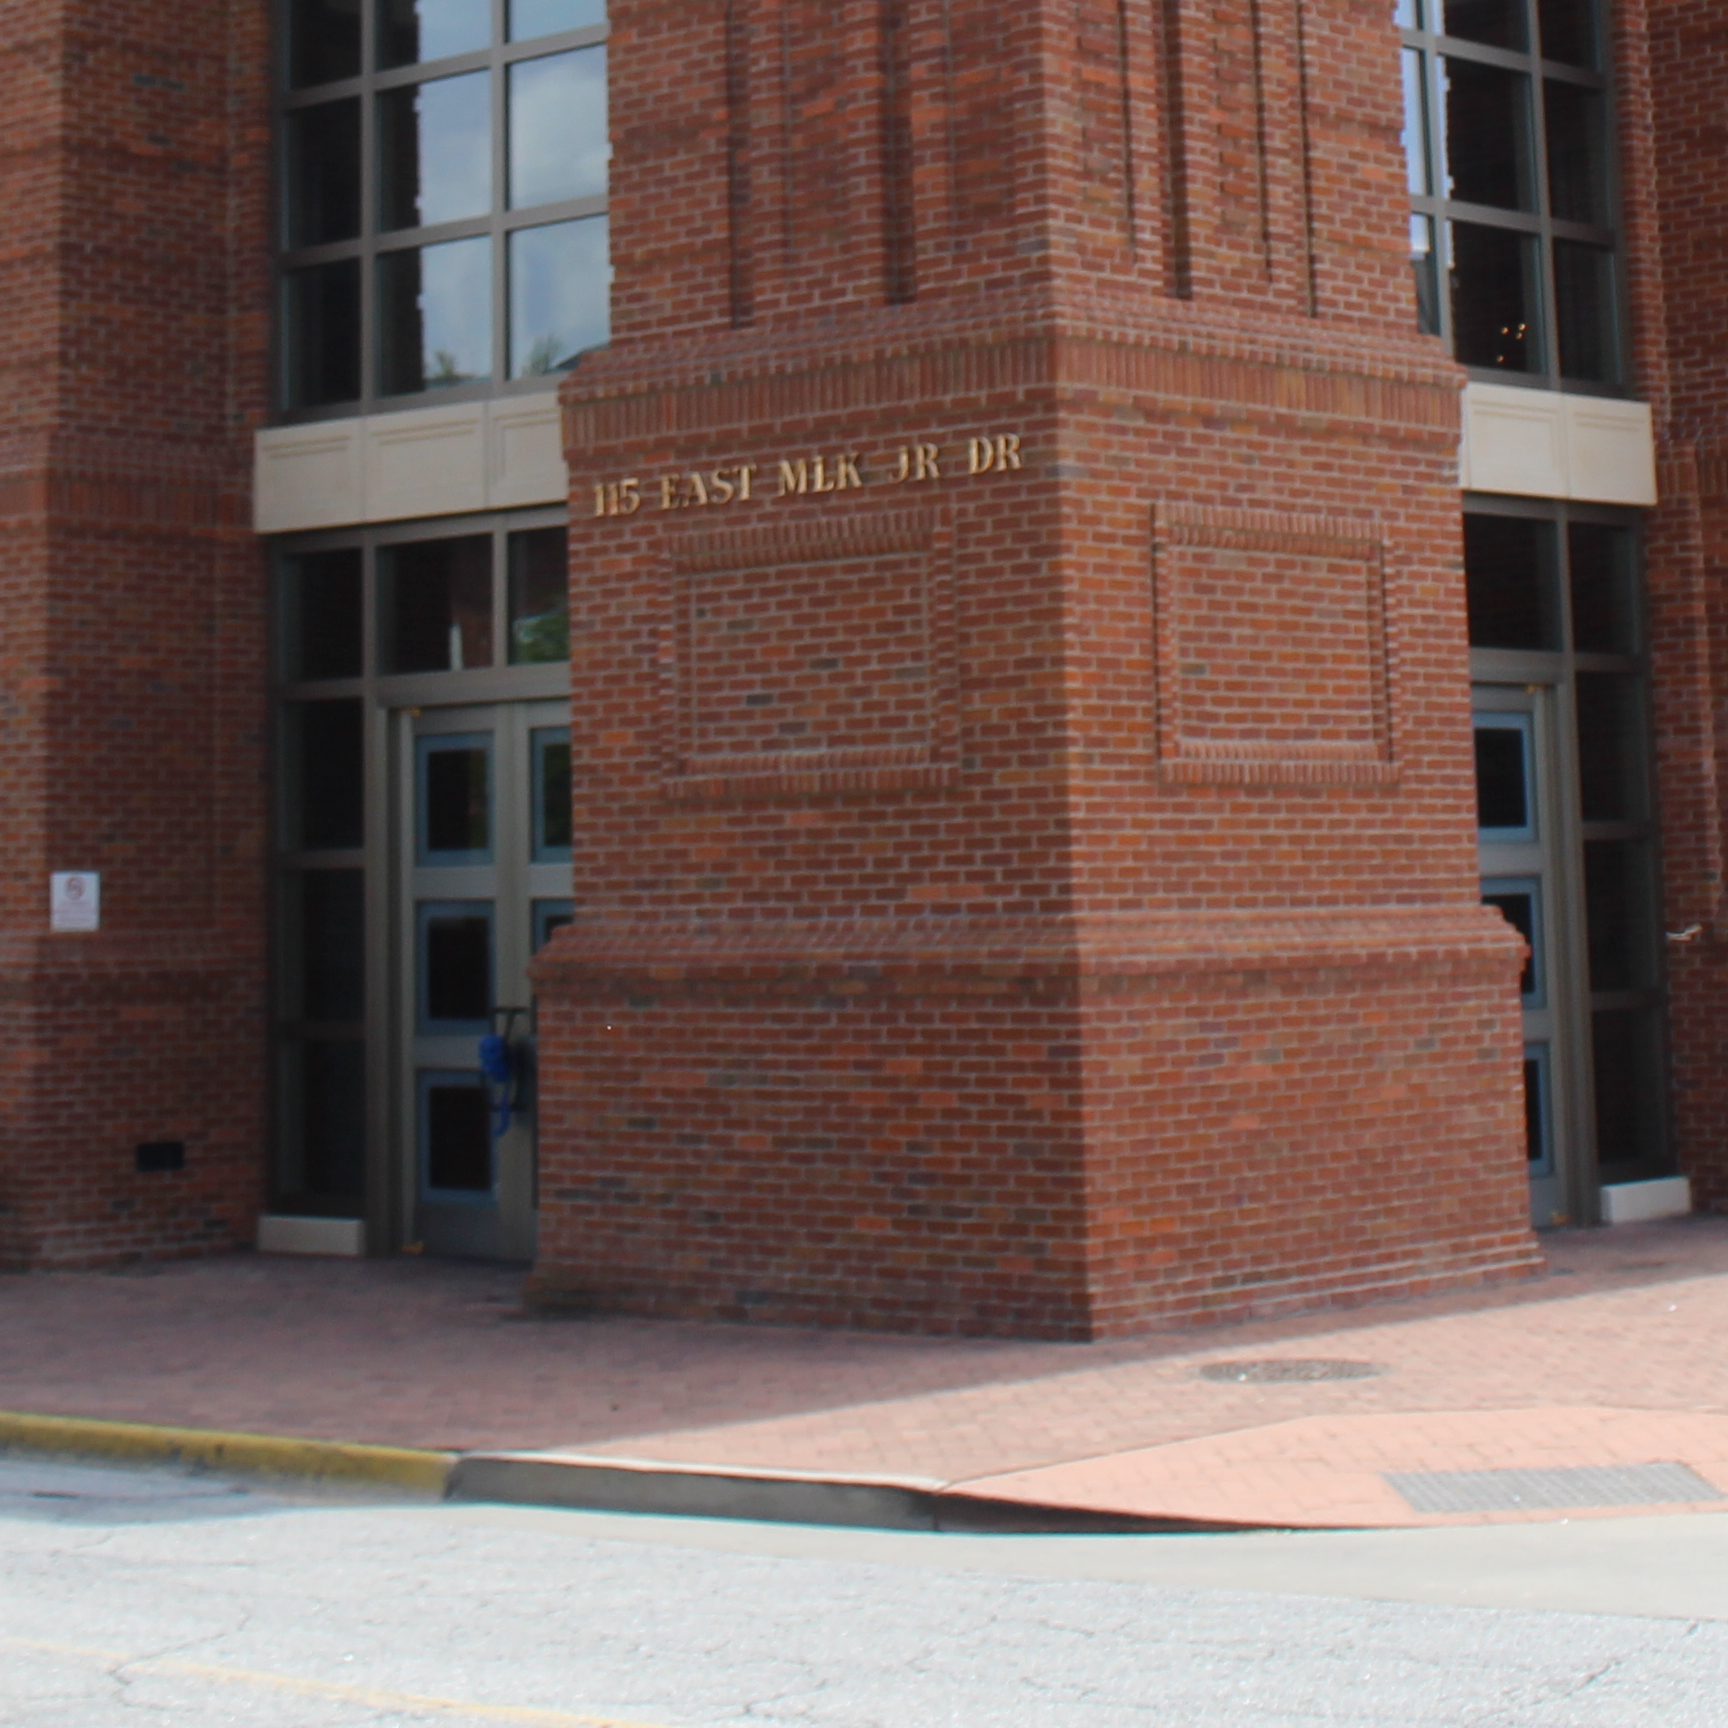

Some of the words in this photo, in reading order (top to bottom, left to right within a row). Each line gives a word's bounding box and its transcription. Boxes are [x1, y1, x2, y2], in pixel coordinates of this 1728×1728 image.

[593, 477, 641, 517] 115
[659, 464, 757, 511] EAST
[777, 451, 863, 498] MLK
[890, 441, 941, 484] JR
[969, 432, 1023, 476] DR
